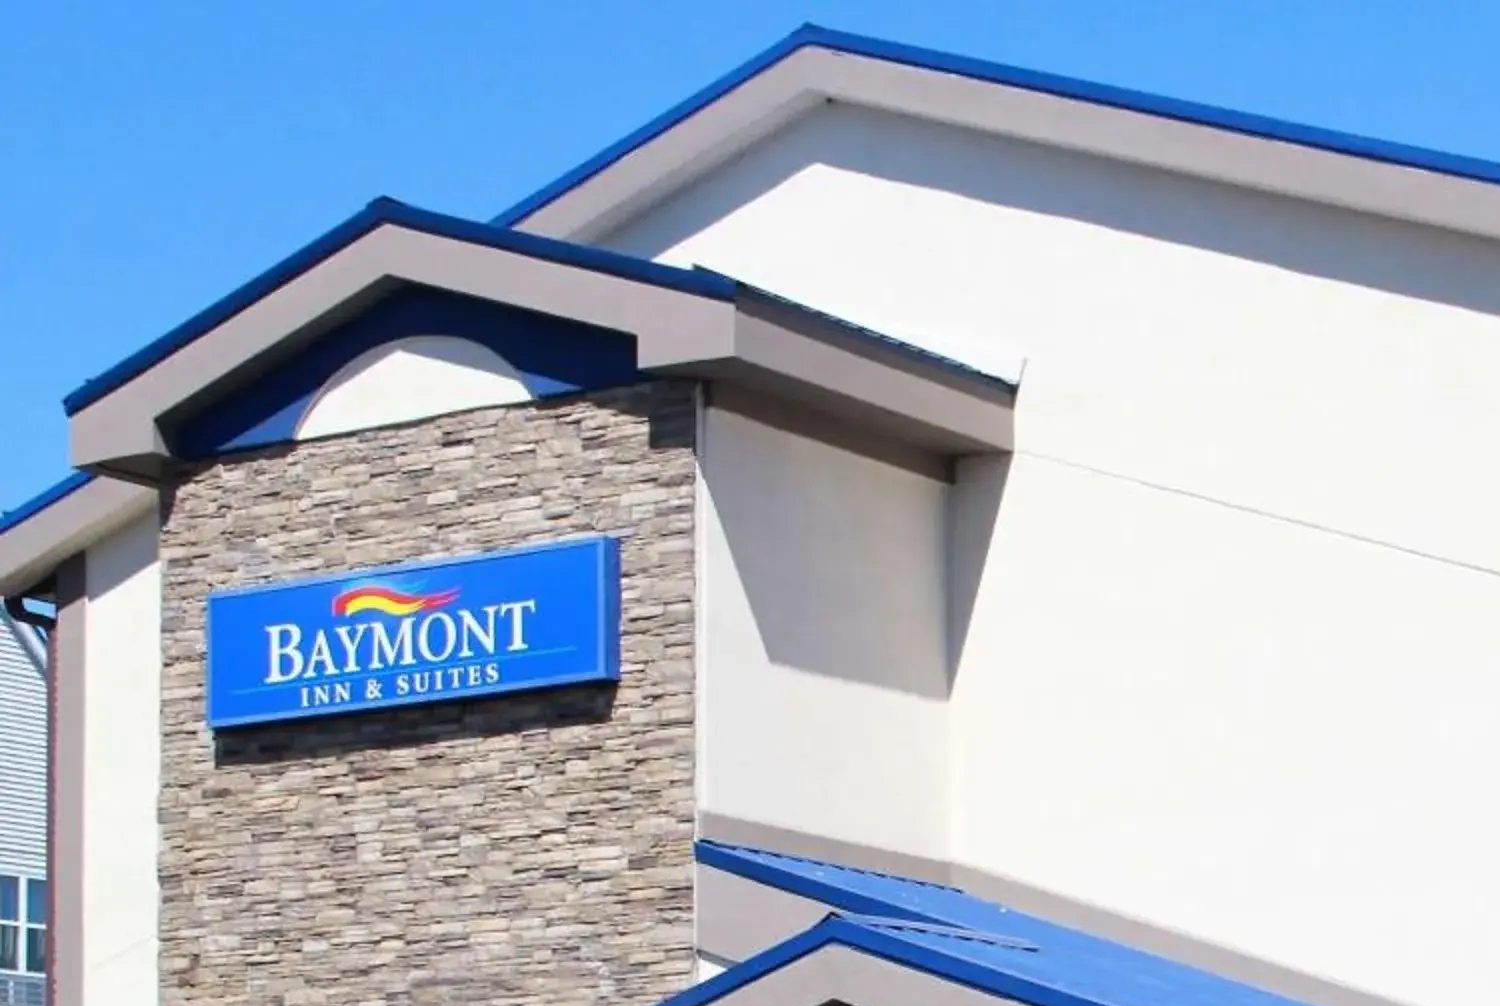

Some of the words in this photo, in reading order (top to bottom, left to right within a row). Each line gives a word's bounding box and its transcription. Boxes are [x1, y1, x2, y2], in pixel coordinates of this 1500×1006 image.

[263, 599, 537, 684] BAYMONT
[301, 682, 351, 708] INN
[365, 678, 383, 699] &
[396, 663, 500, 696] SUITES
